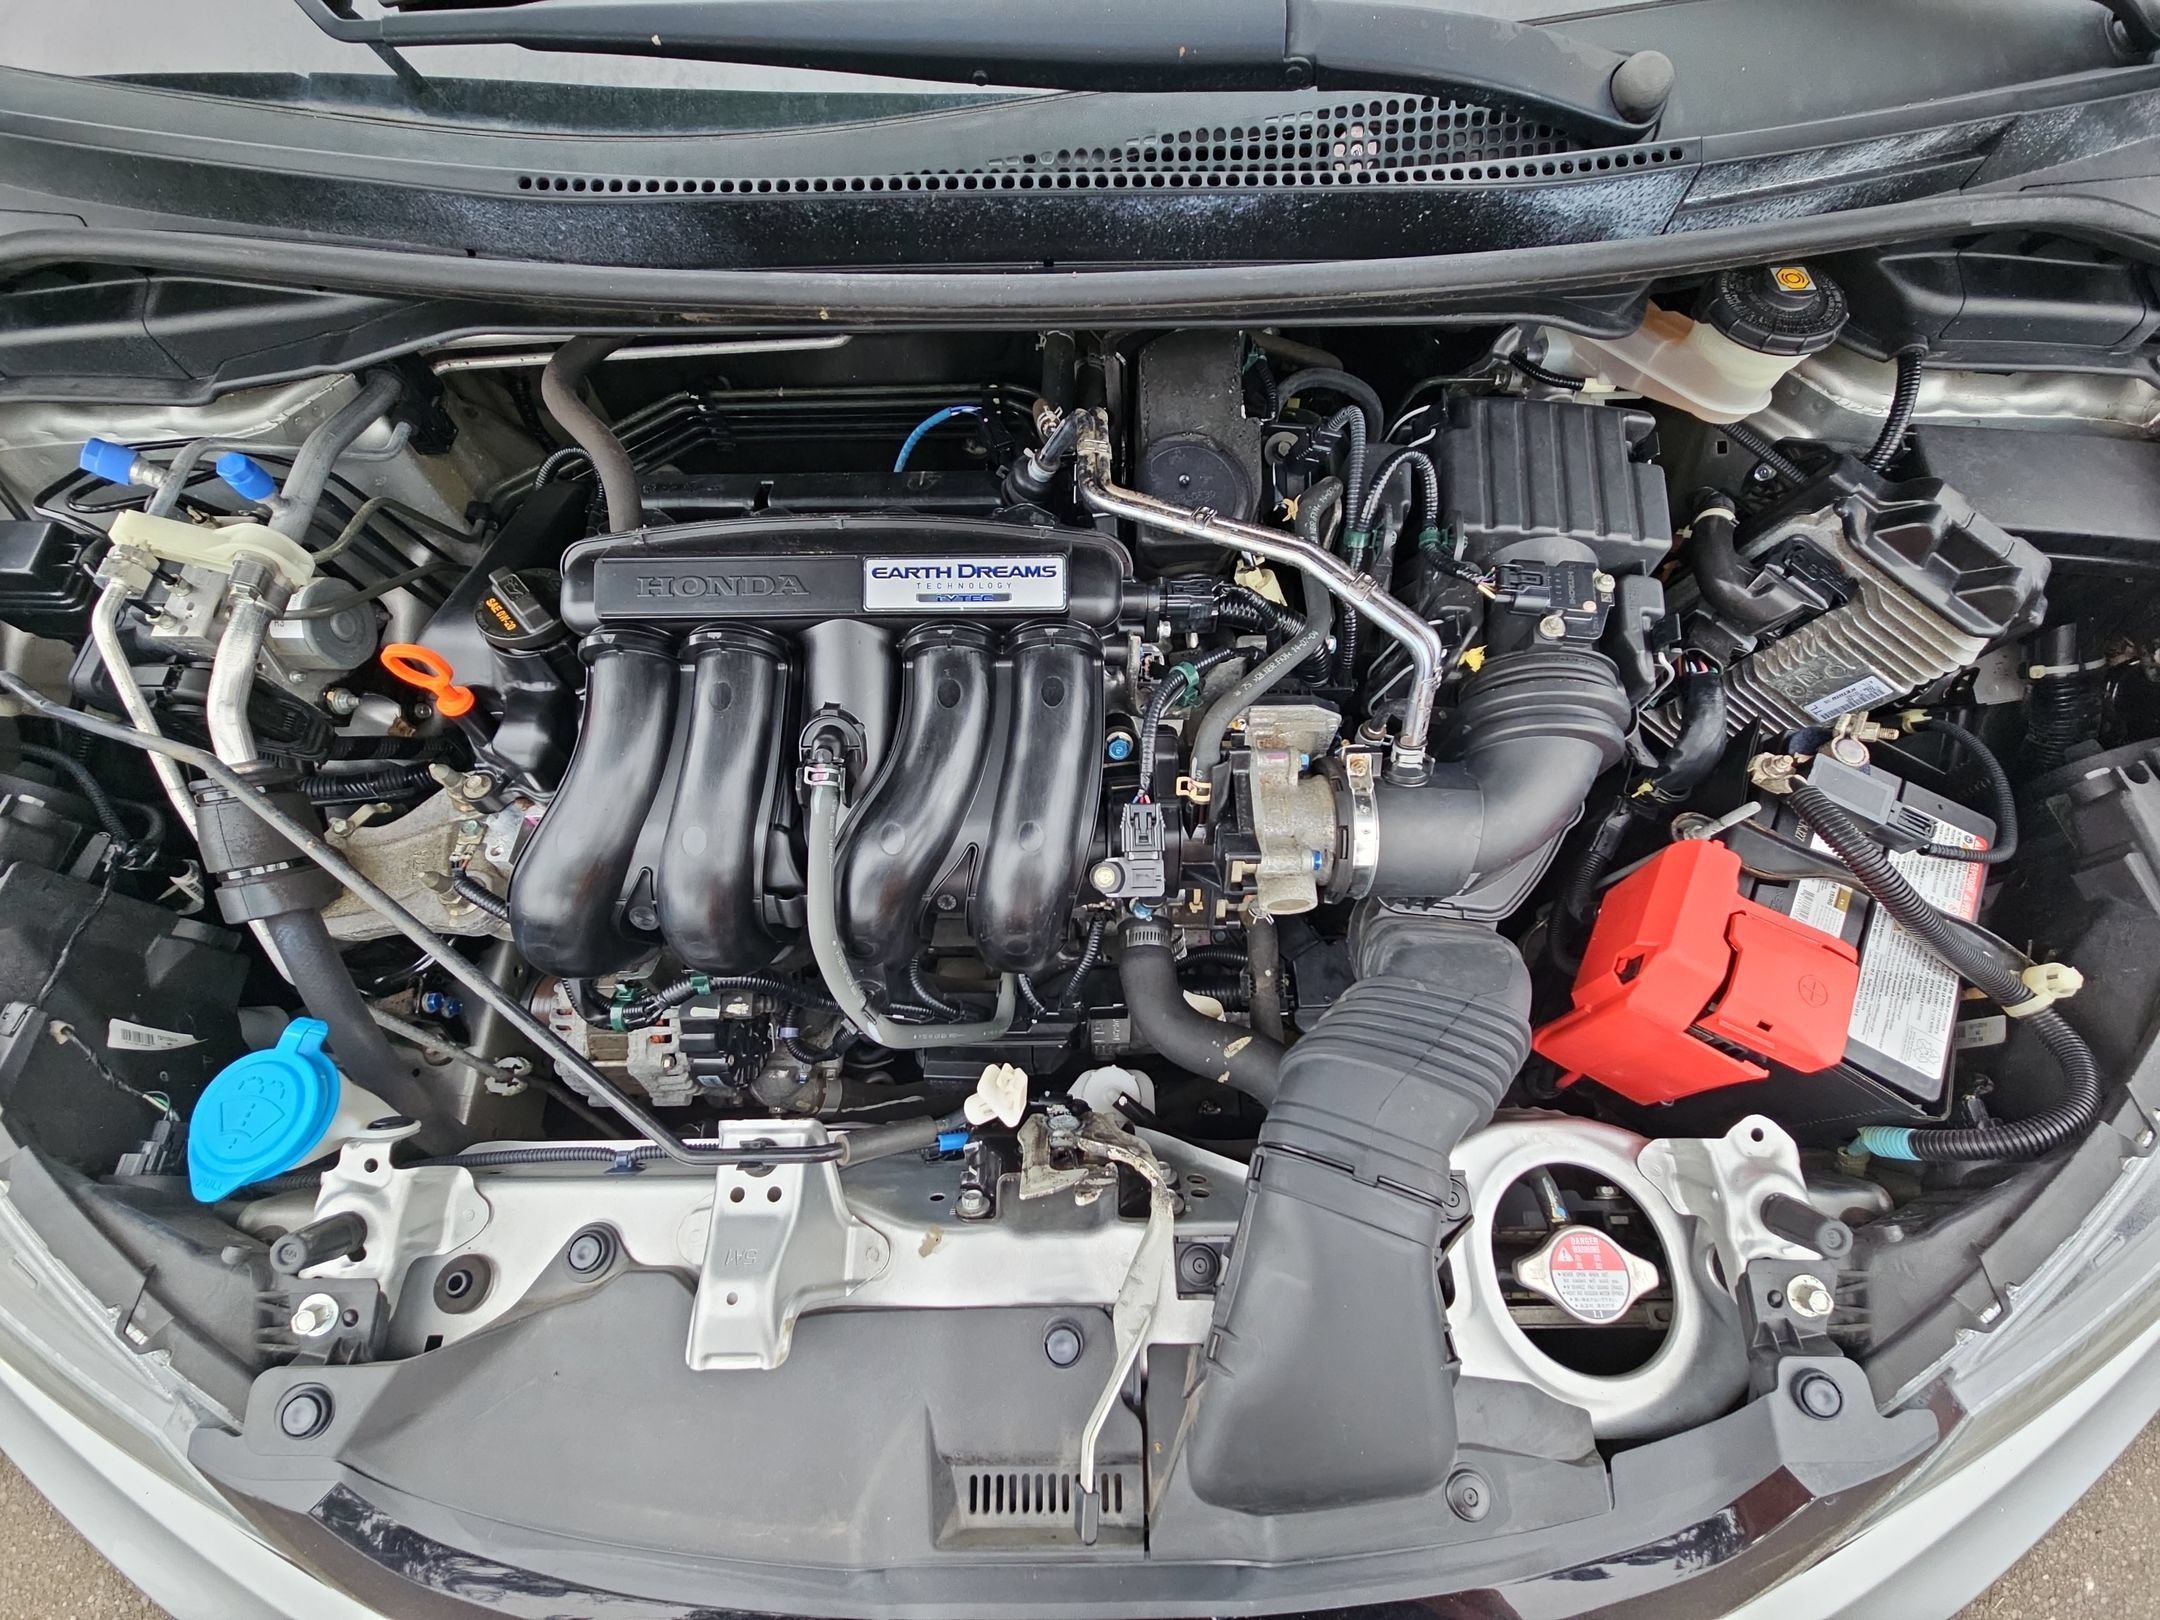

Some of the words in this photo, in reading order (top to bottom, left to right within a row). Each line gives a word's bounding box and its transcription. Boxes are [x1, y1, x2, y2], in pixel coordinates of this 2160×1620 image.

[871, 566, 949, 579] EARTH
[957, 563, 1057, 579] DREAMS
[636, 574, 810, 598] HONDA
[916, 582, 1013, 590] TECHNOLOGY
[1567, 570, 1577, 605] HITACHI
[485, 597, 503, 614] SAE
[495, 610, 517, 631] 0W-20
